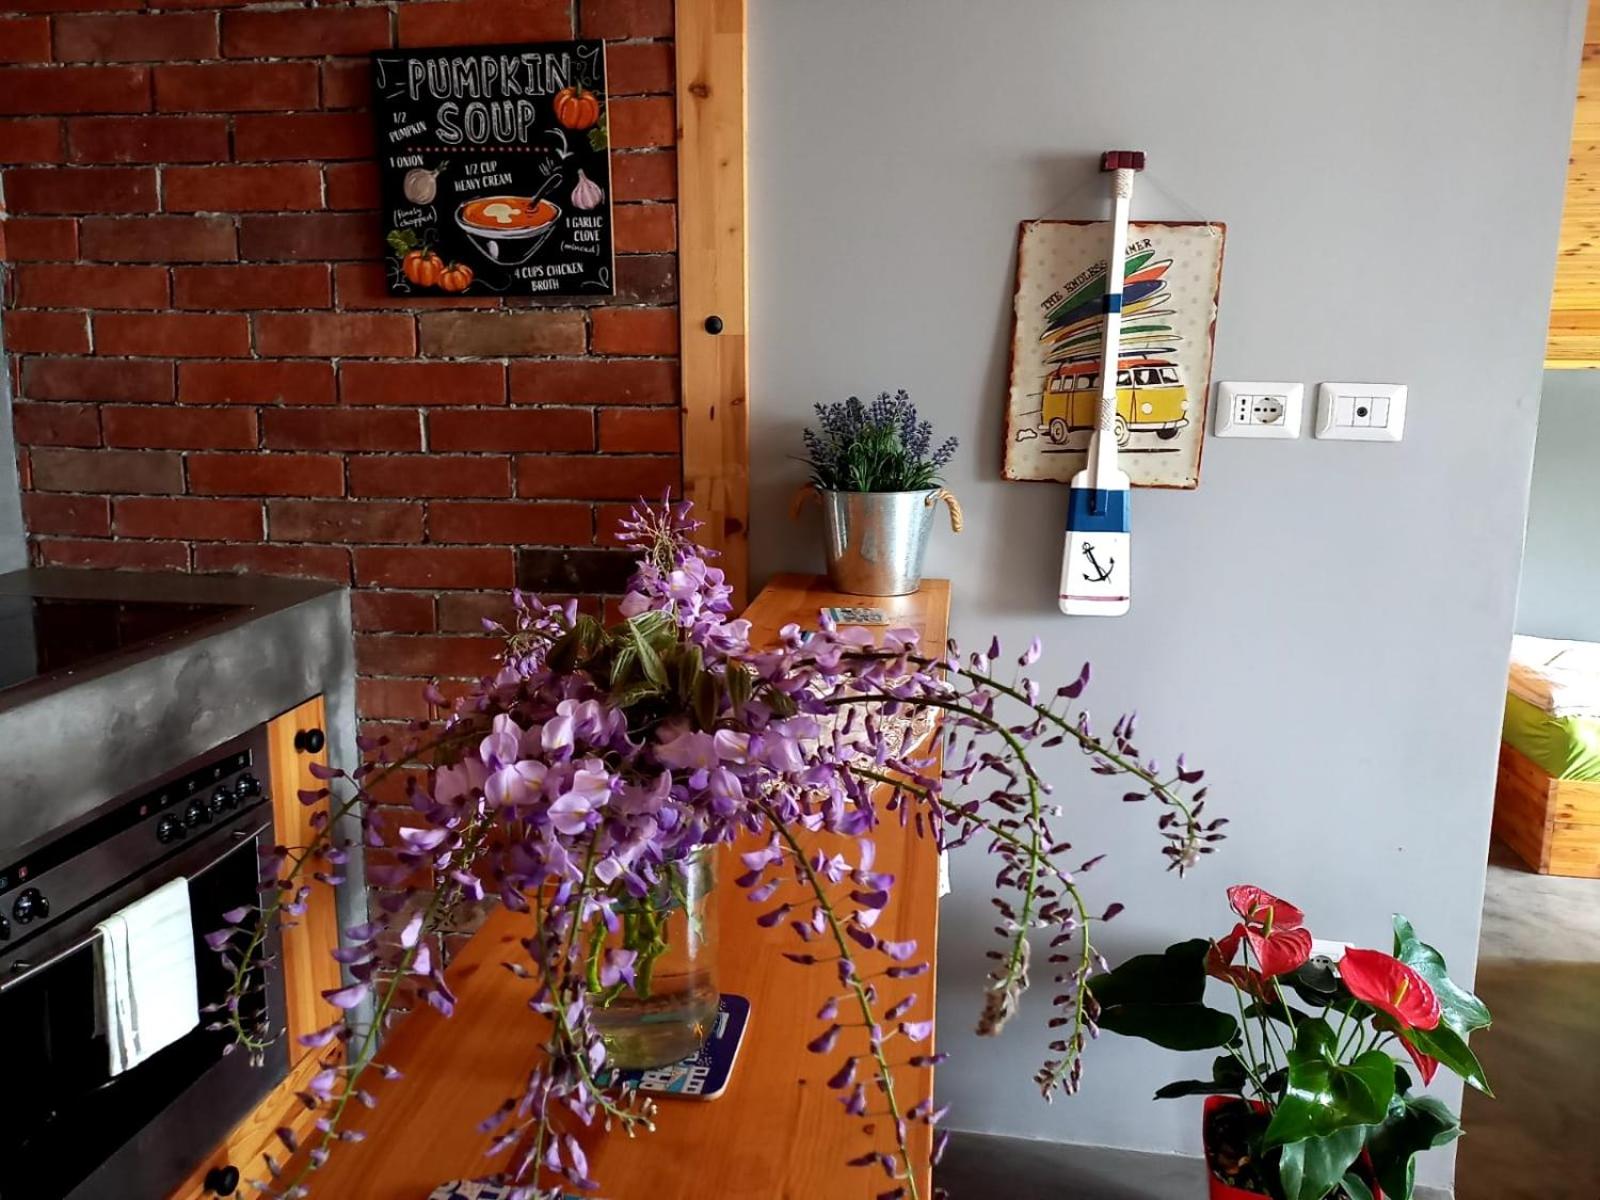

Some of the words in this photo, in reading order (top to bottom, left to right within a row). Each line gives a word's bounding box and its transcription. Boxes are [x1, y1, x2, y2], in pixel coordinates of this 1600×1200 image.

[407, 53, 571, 101] PUMPKIN
[393, 111, 407, 124] 1/2
[435, 100, 536, 144] SOUP
[388, 120, 428, 143] PUMPKIN
[396, 154, 425, 168] ONION
[480, 160, 498, 174] CUP
[454, 178, 481, 192] HEAVY
[482, 172, 513, 188] CREAM
[572, 215, 603, 228] GARLIC
[573, 229, 600, 242] CLOVE
[514, 268, 521, 279] 4
[521, 265, 544, 279] CUPS
[546, 262, 584, 277] CHICKEN
[1041, 290, 1064, 311] THE
[1063, 259, 1109, 294] ENDLESS
[1125, 238, 1152, 255] MER
[530, 278, 560, 292] BROTH
